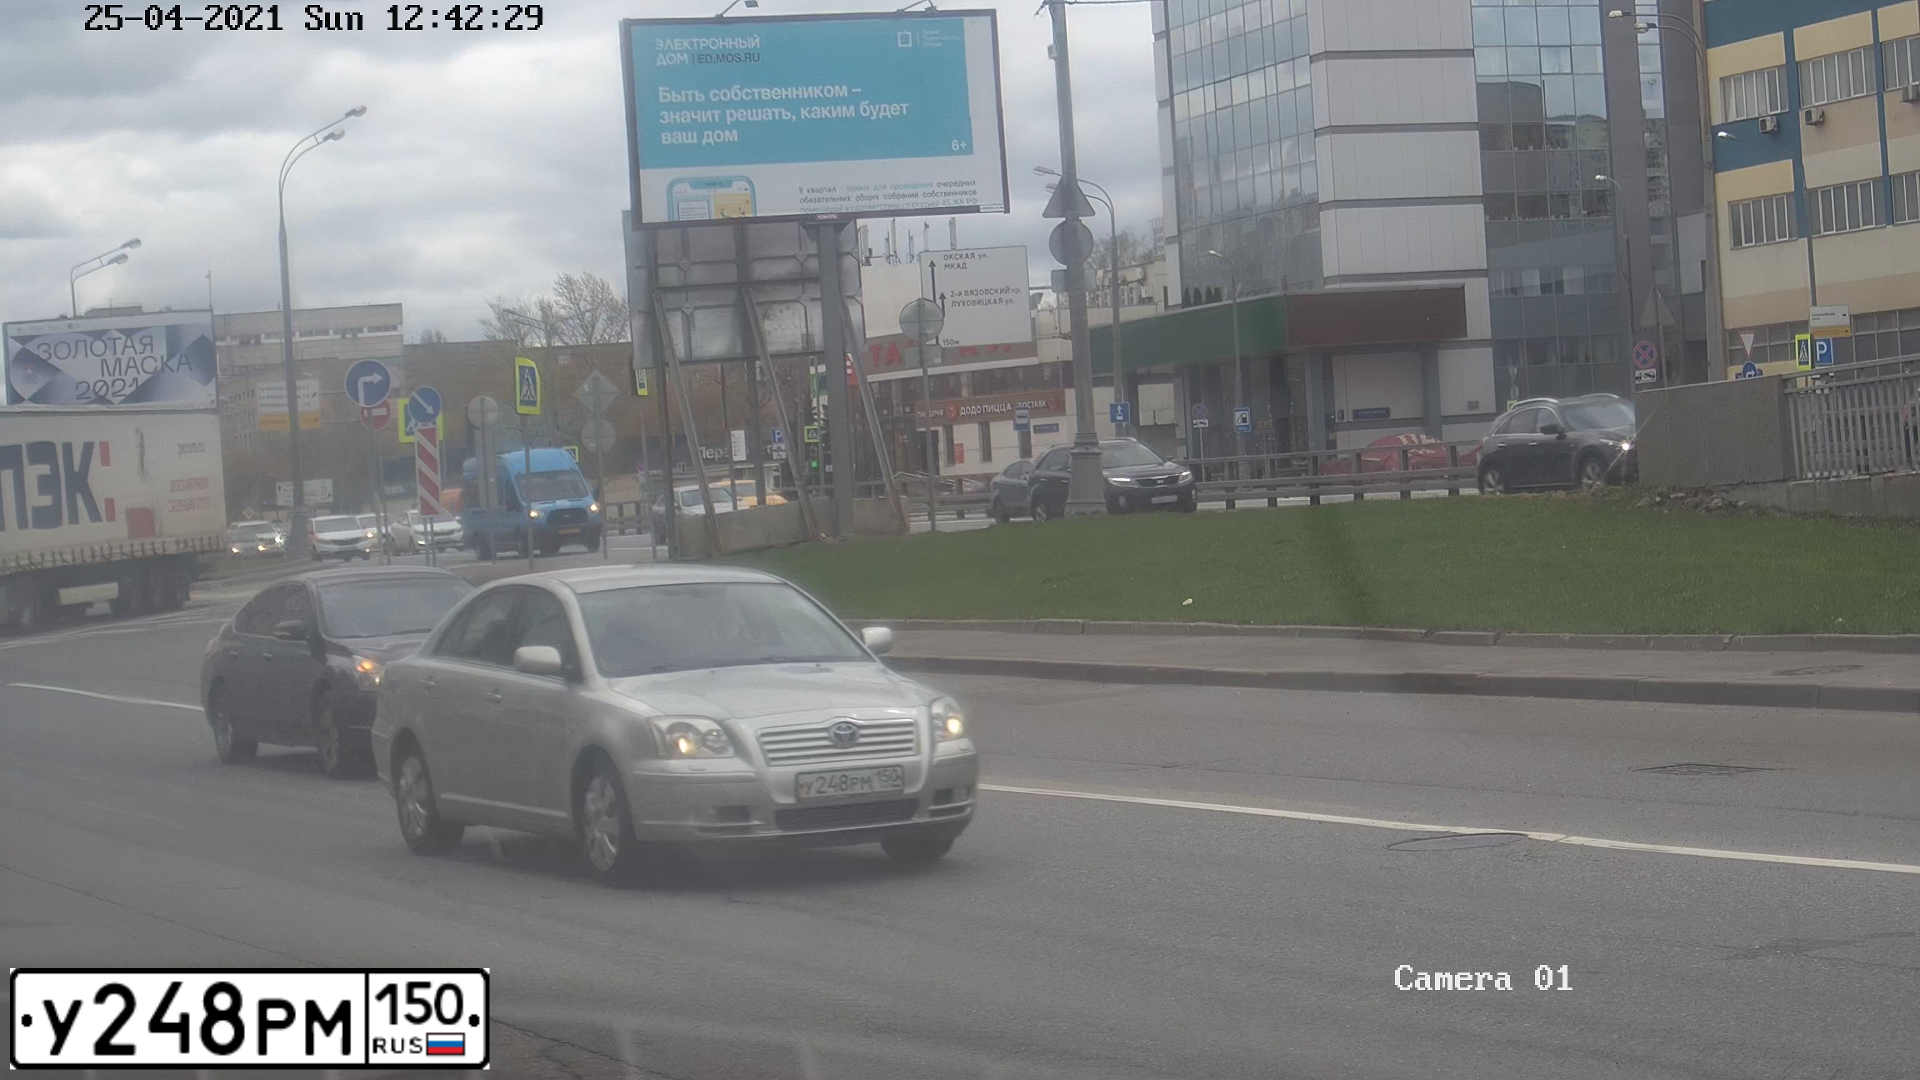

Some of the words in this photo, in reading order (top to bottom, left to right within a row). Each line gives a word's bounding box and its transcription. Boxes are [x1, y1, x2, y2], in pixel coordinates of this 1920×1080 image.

[654, 34, 760, 51] ЭЛЕКТРОННЫЙ
[656, 53, 688, 66] ДОМ
[697, 53, 760, 64] ED.MOS.RU
[658, 86, 705, 103] Быть
[709, 84, 848, 102] собственником
[659, 109, 721, 124] значит
[725, 107, 796, 125] решать,
[801, 104, 855, 119] каким
[859, 101, 909, 120] будет
[661, 131, 697, 145] ваш
[702, 129, 738, 146] дом
[951, 139, 967, 151] 6+
[923, 189, 978, 199] собственников
[943, 252, 976, 262] ОКСКАЯ
[944, 262, 968, 270] МКАД
[964, 286, 1011, 297] ВЯЗОВСКИЙ
[951, 298, 1004, 308] ЛУХОВИЦКАЯ
[36, 335, 155, 362] ЗОЛОТАЯ
[101, 353, 193, 378] МАСКА
[75, 377, 140, 400] 2021
[960, 405, 981, 417] ДОДО
[983, 402, 1013, 414] ПИЦЦА
